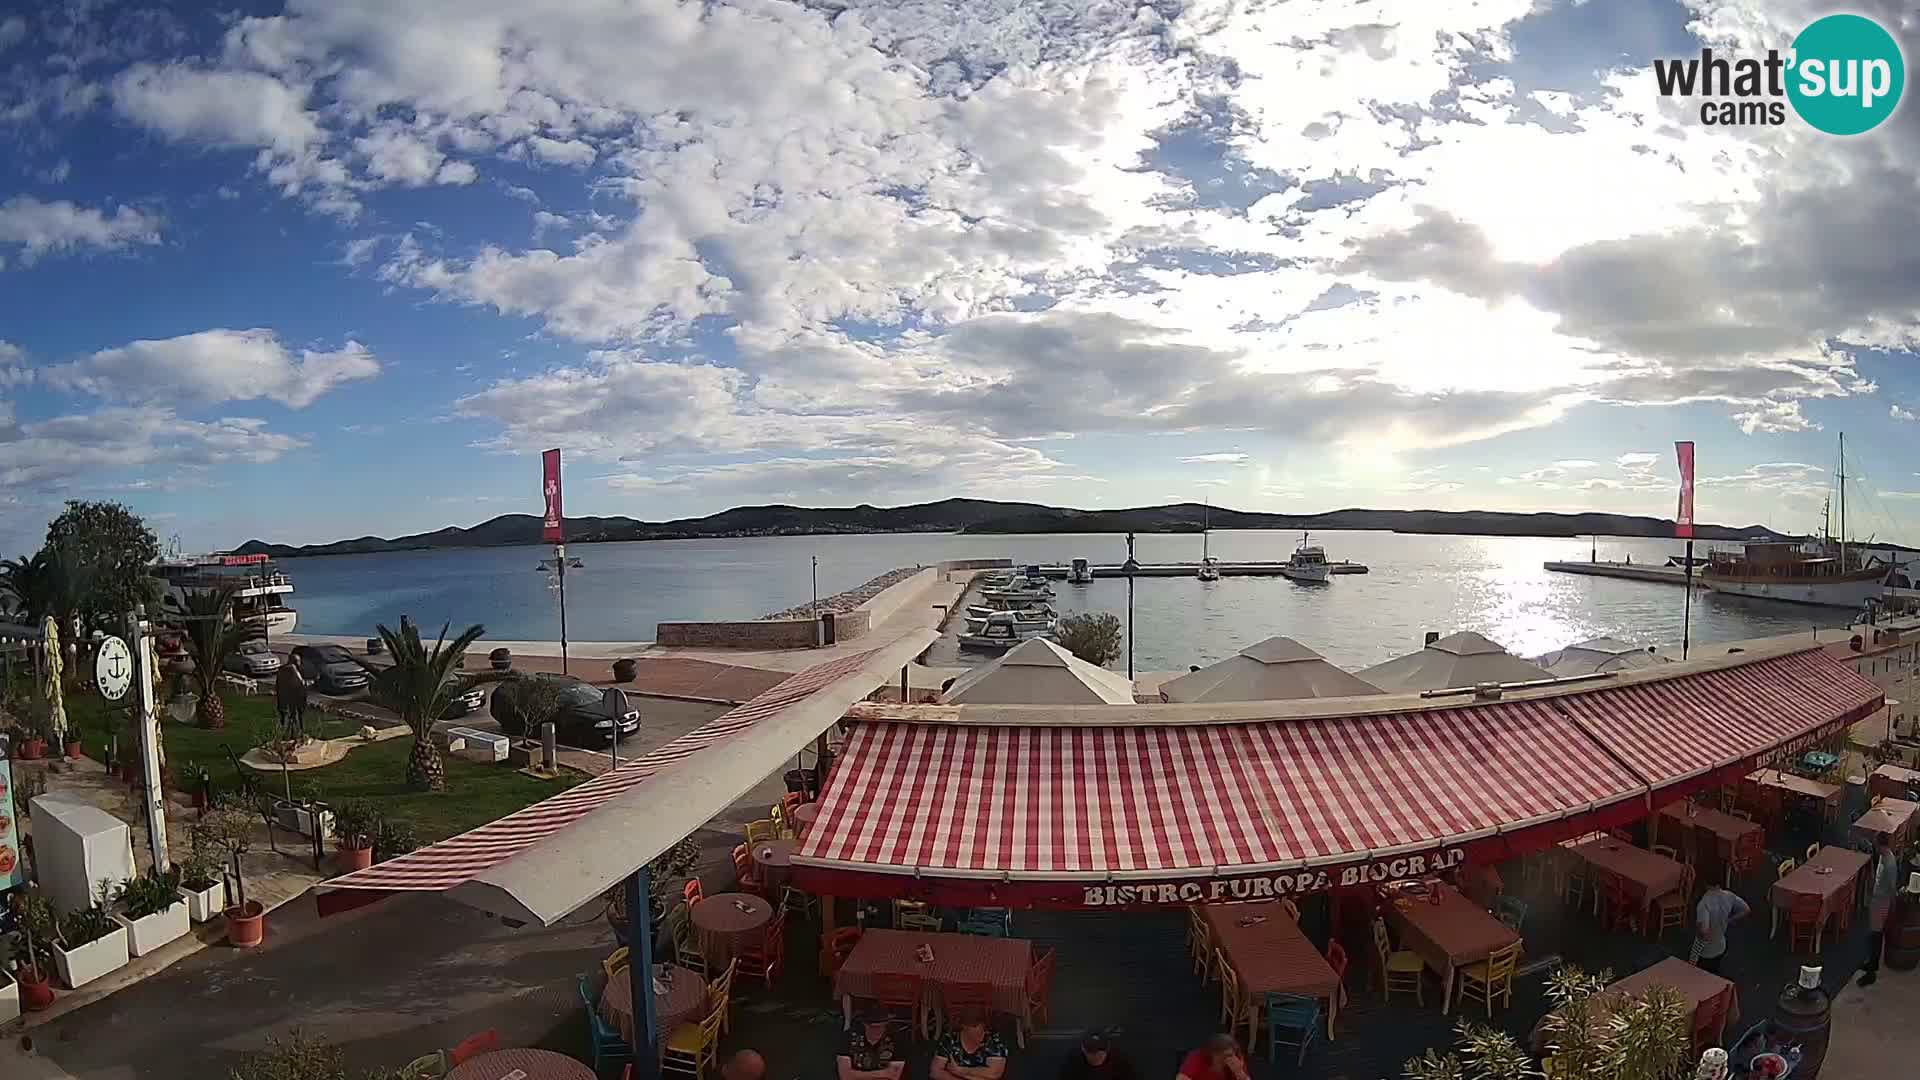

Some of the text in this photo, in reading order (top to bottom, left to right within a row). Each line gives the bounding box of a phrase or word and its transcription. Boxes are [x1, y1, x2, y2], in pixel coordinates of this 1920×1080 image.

[1083, 848, 1465, 905] BISTRO EUROPA BIOGRAD
